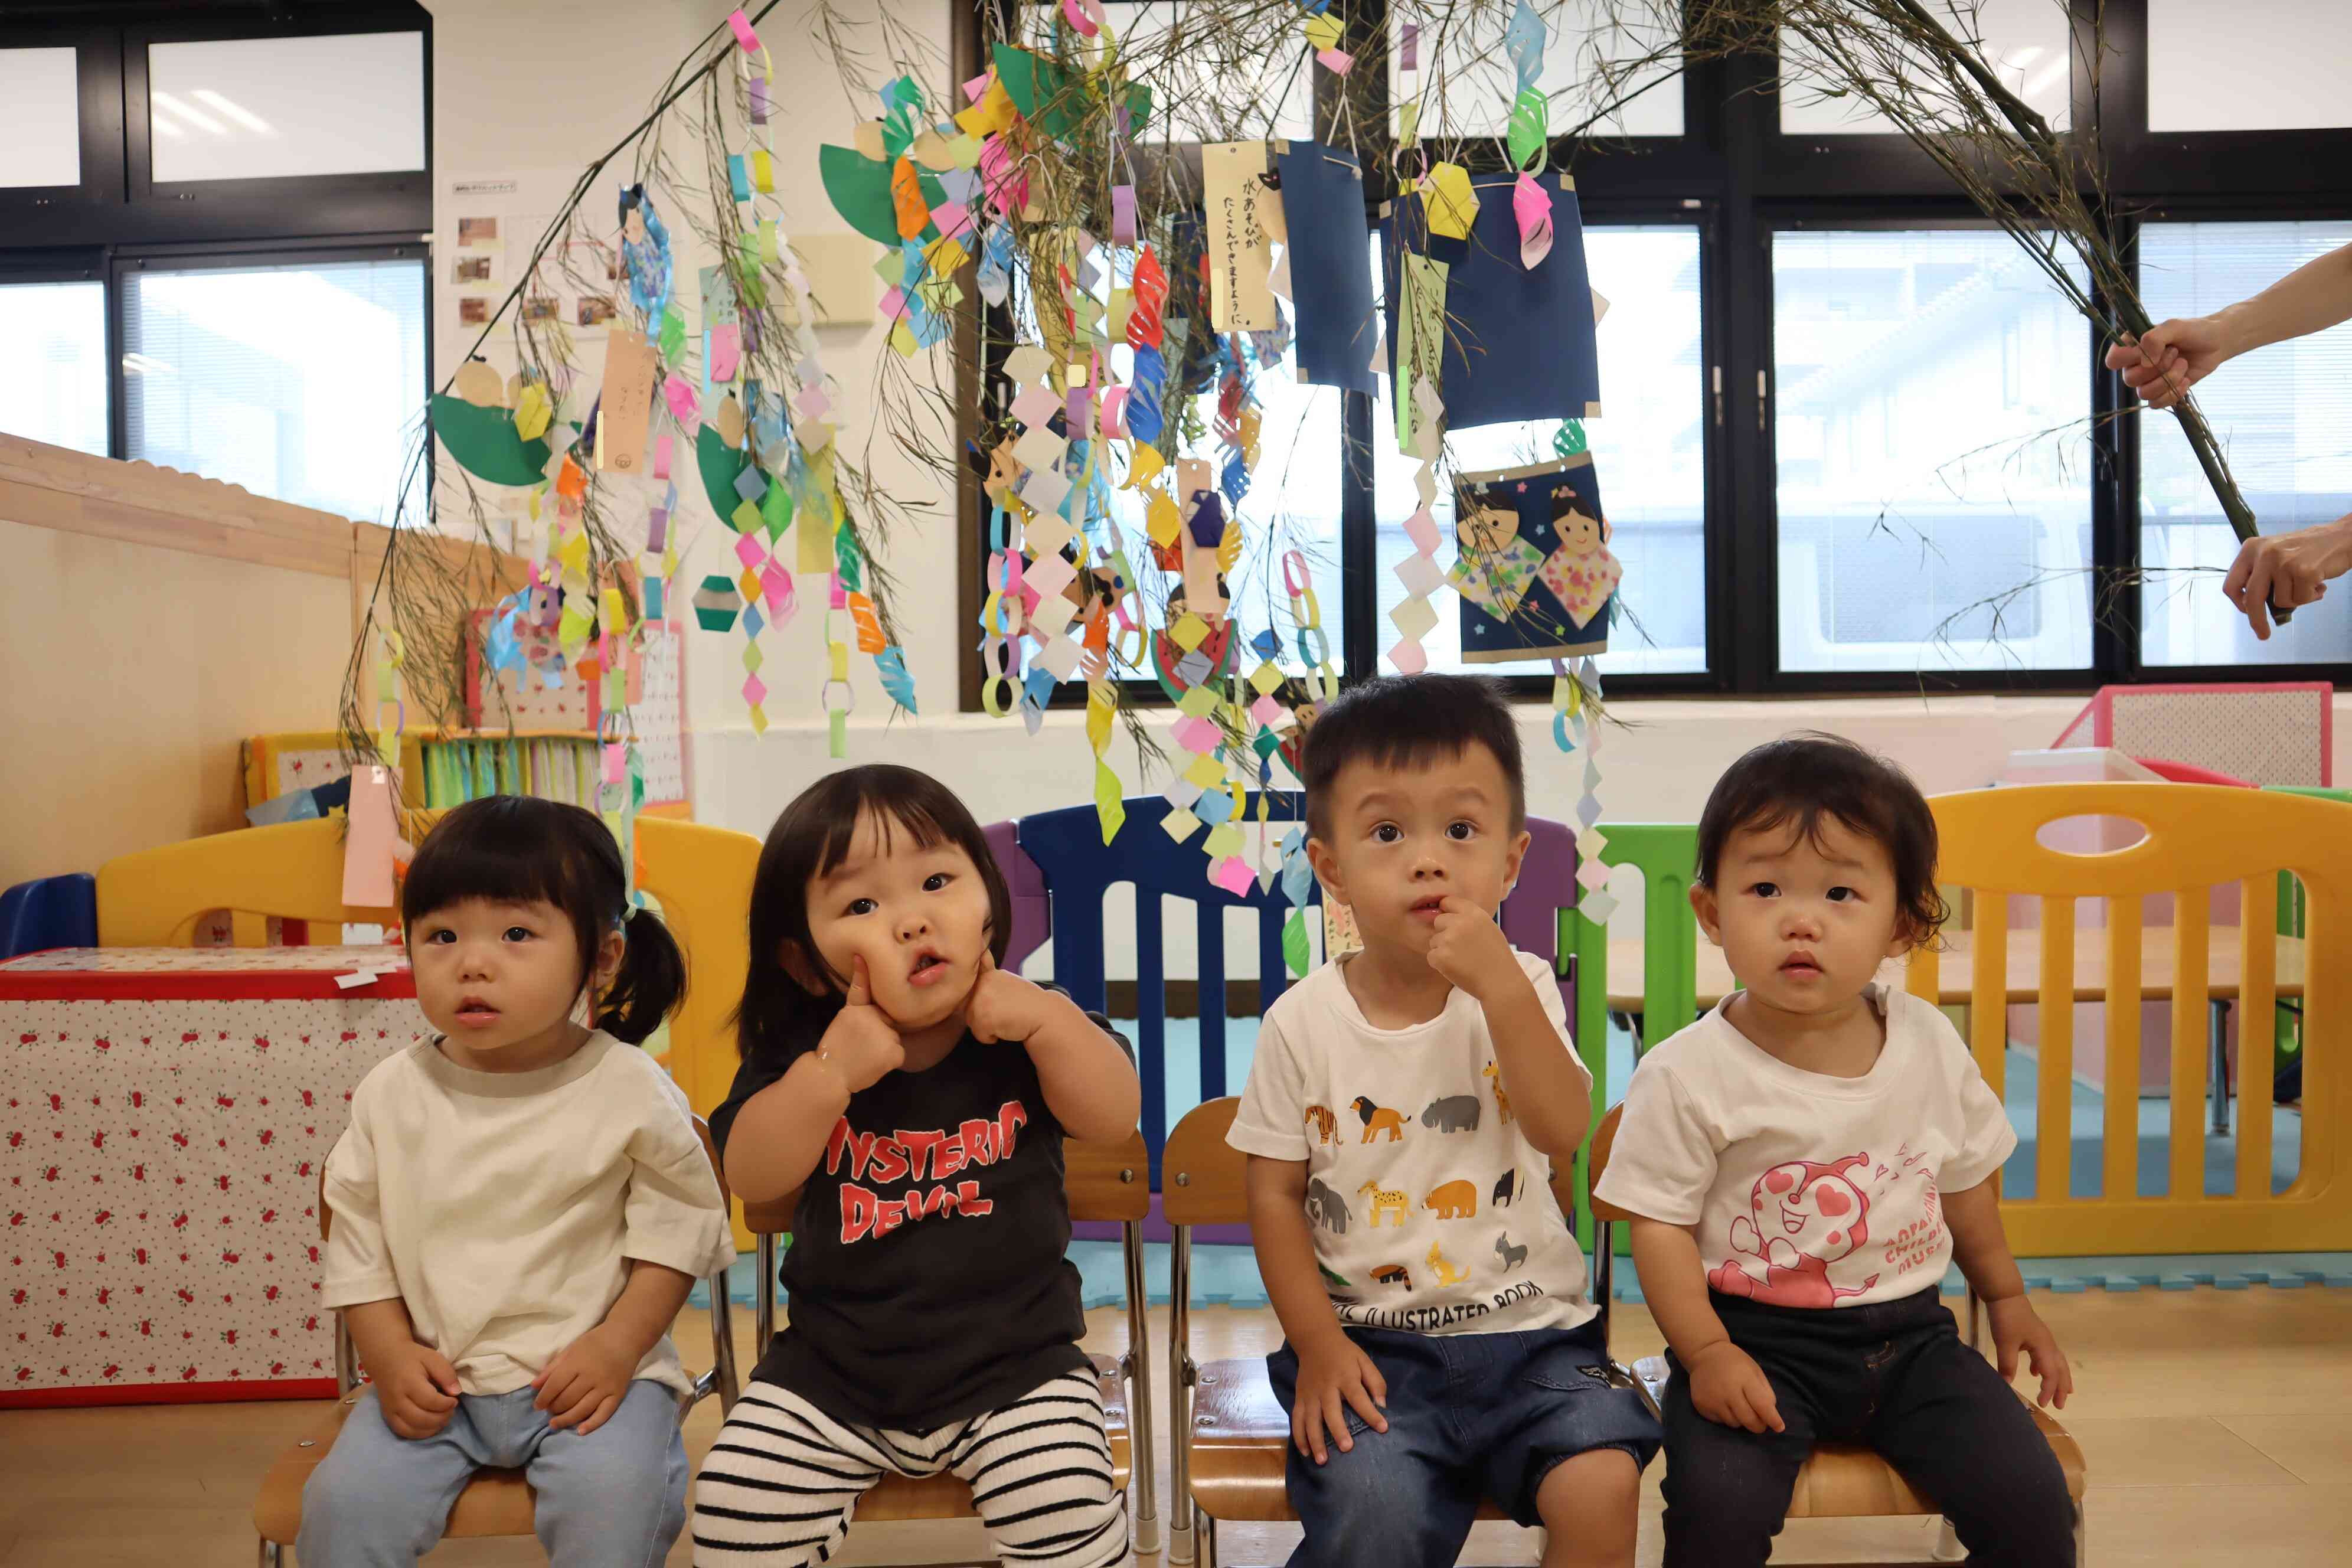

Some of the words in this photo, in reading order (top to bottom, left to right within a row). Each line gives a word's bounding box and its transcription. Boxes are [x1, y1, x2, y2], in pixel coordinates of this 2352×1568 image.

[1242, 177, 1262, 249] 水あそびが
